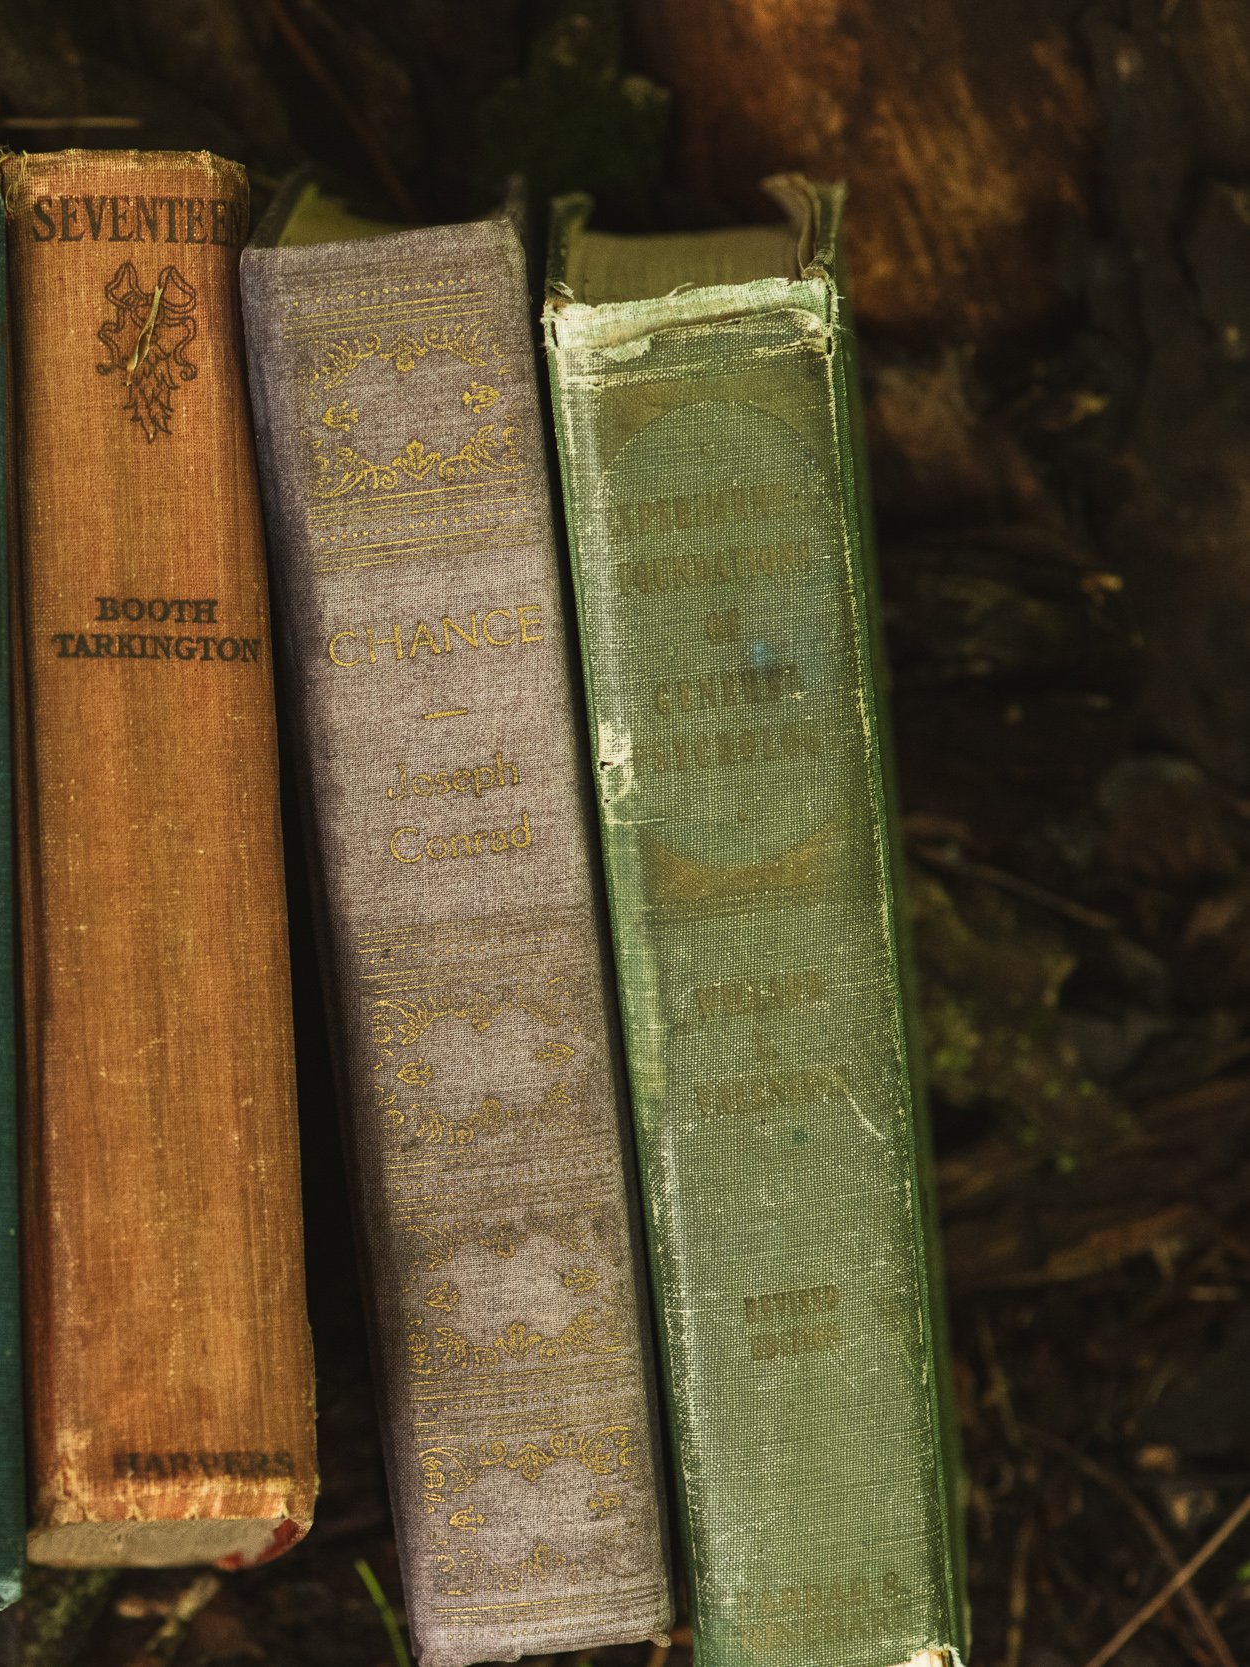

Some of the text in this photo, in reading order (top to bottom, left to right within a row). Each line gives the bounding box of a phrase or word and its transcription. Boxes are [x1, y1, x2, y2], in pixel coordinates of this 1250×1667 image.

[95, 596, 219, 624] BOOTH
[51, 632, 262, 664] TARKINGTON
[328, 605, 544, 668] CHANCE
[387, 751, 520, 801] Joseph
[389, 811, 532, 864] Conrad
